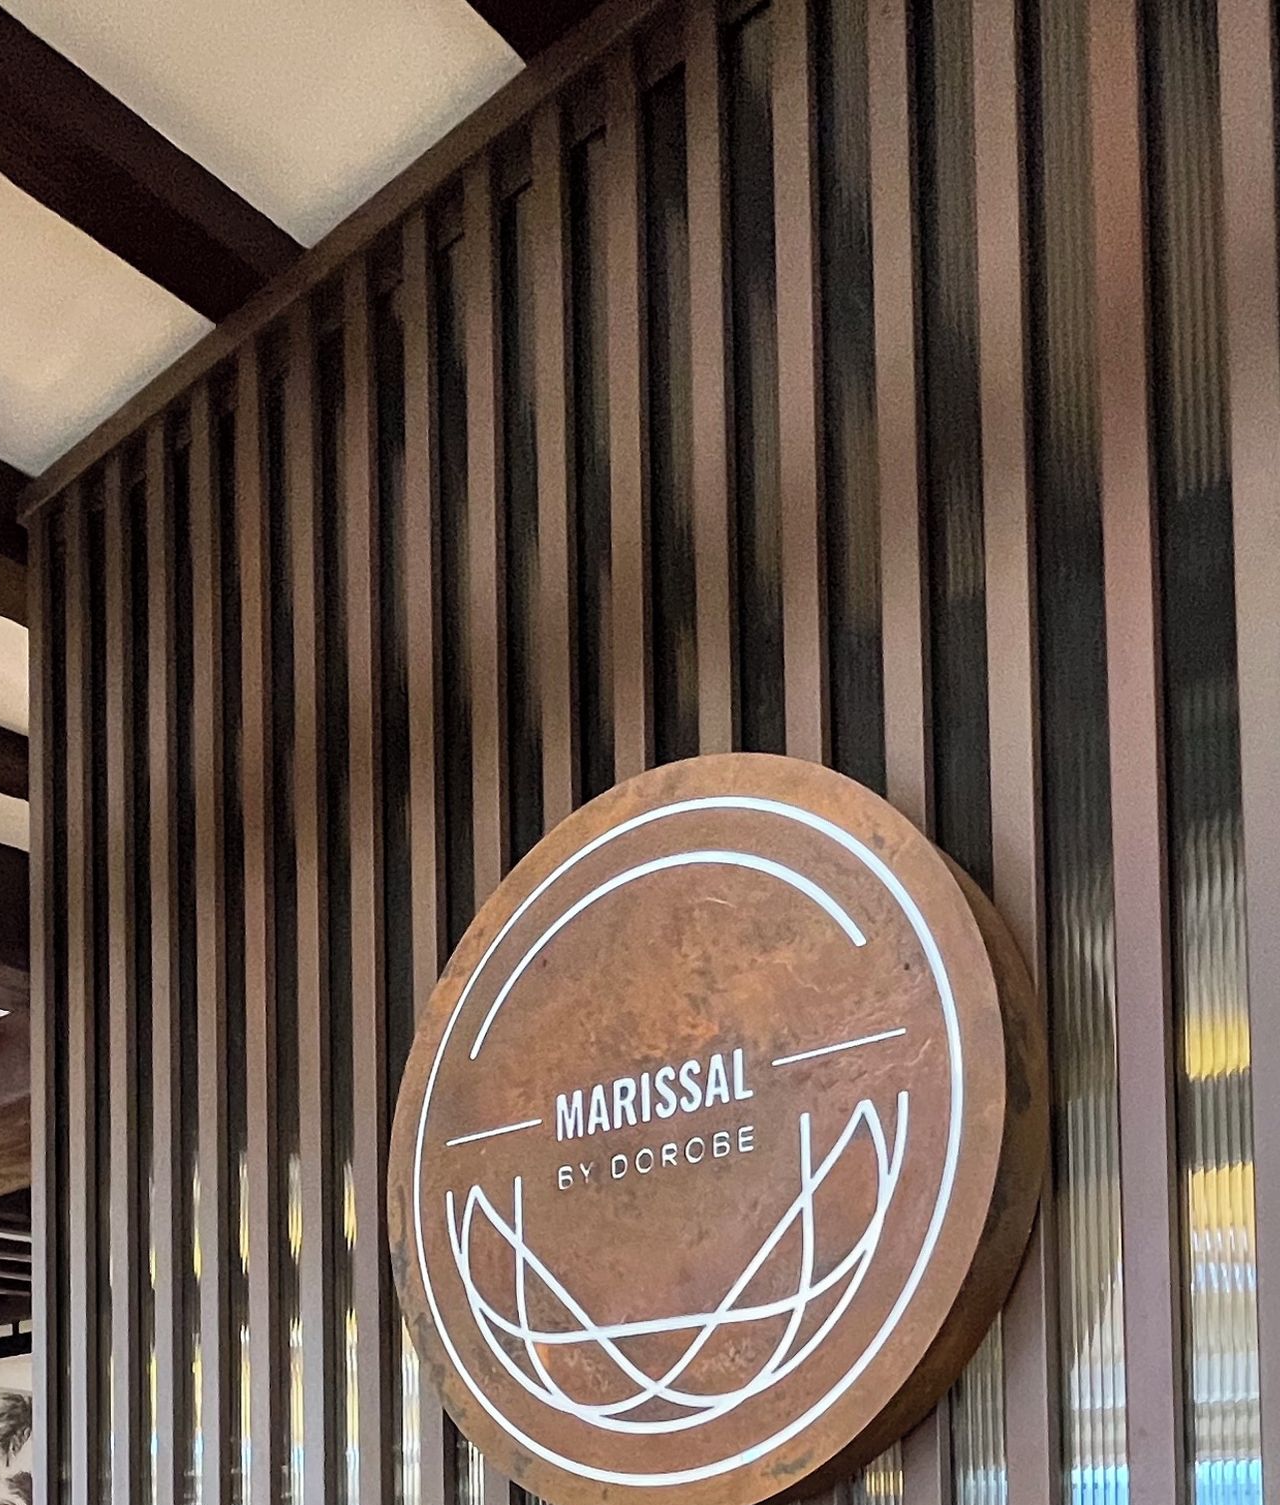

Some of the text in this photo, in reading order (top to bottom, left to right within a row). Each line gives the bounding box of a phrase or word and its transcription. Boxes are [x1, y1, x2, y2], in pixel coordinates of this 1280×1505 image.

[556, 1047, 755, 1142] MARISSAL
[558, 1125, 756, 1190] BY DOROBE
